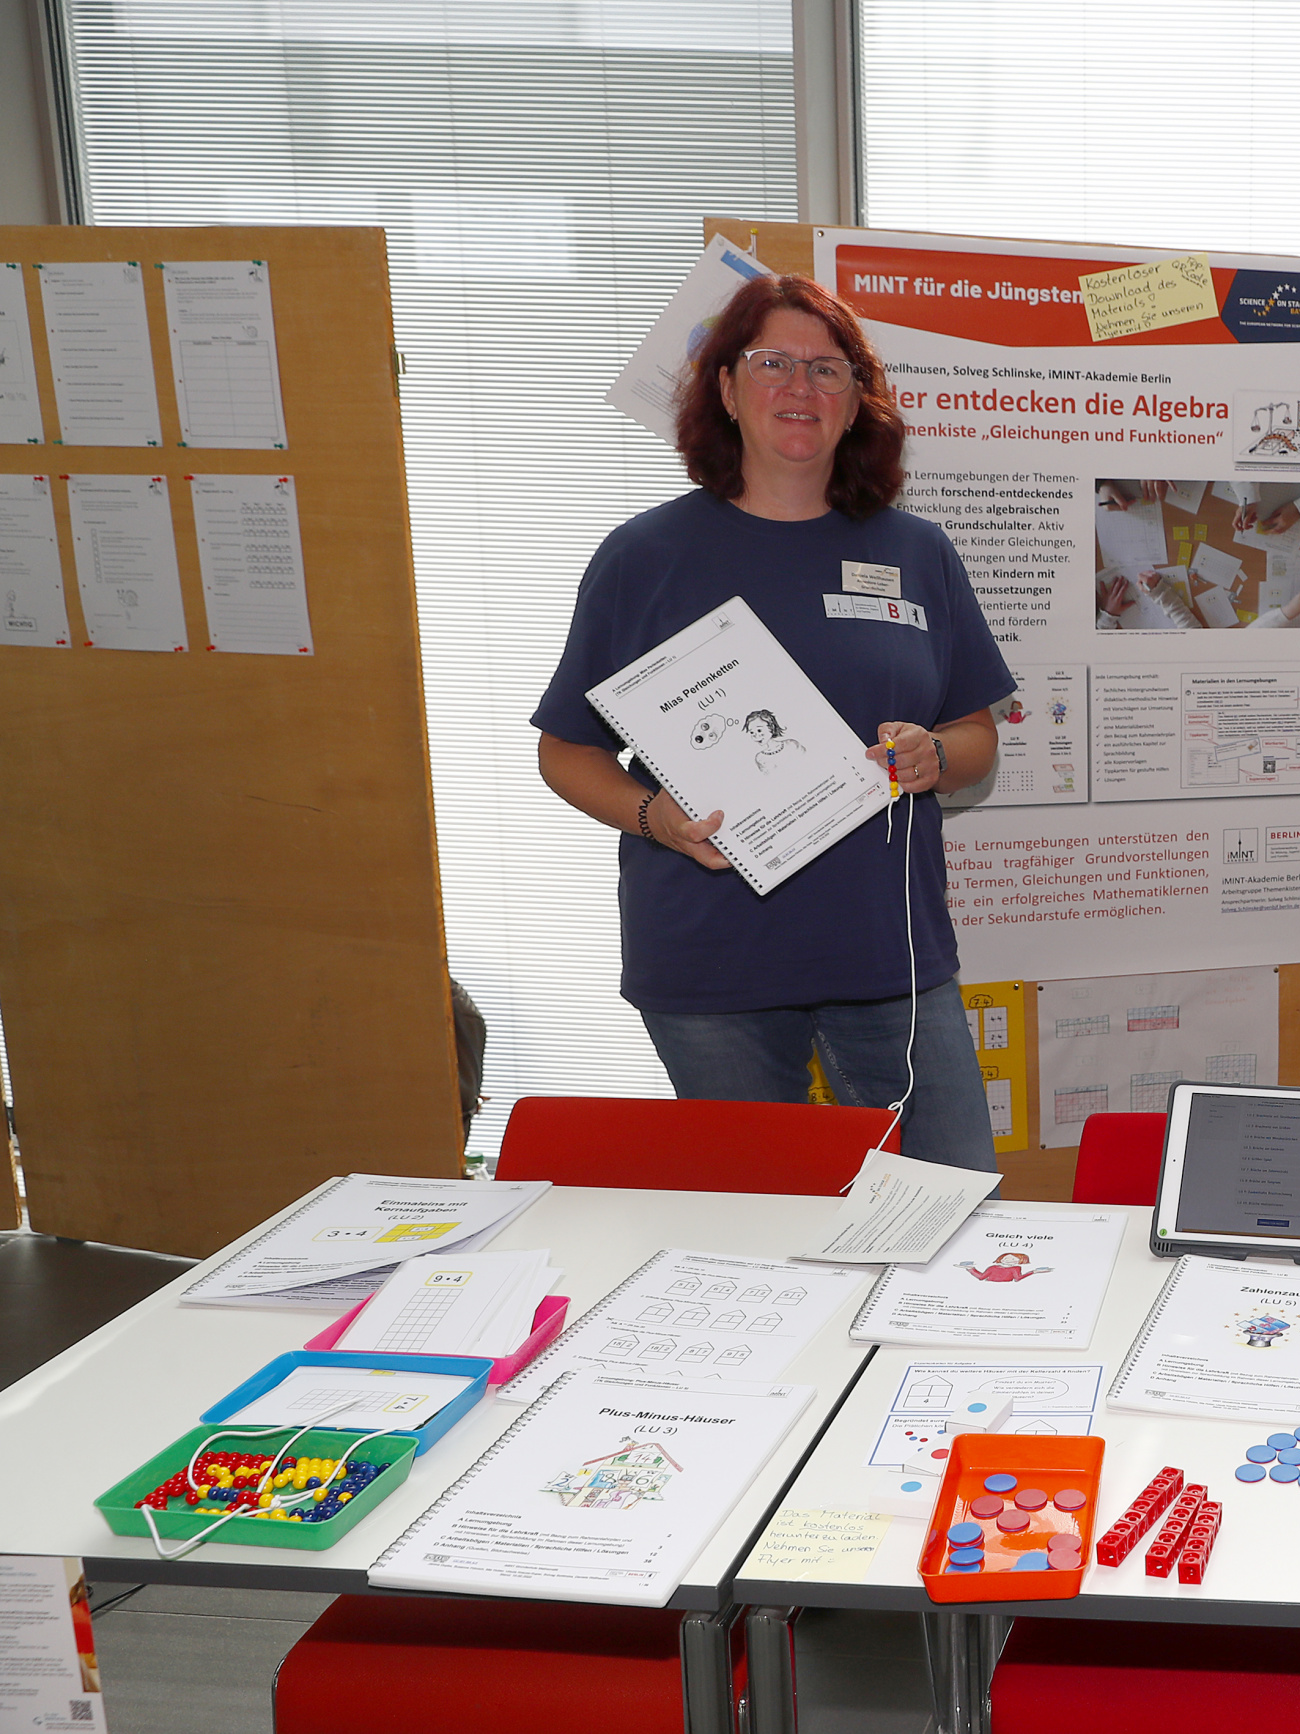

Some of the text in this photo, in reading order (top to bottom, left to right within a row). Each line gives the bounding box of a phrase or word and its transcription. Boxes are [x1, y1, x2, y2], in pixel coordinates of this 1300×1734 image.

[1086, 264, 1161, 290] Kostenloser
[855, 274, 1085, 305] MINT für die Jüngsten
[1087, 280, 1176, 305] Download des
[1239, 298, 1265, 306] SCIENCE
[953, 366, 989, 378] Solveg
[992, 367, 1046, 380] Schlinske,
[1048, 369, 1138, 383] iMINT-Akademie
[1141, 373, 1171, 384] Berlin
[937, 388, 1228, 422] entdecken die Algebra
[1094, 427, 1124, 442] und
[915, 471, 1079, 483] Lernumgebungen der Themen-
[907, 488, 1073, 499] durch forschend-entdeckendes
[965, 506, 983, 514] des
[986, 506, 1059, 516] algebraischen
[946, 521, 1064, 533] Grundschulalter. Aktiv
[971, 538, 1005, 546] Kinder
[1008, 539, 1075, 549] Gleichungen,
[1009, 554, 1070, 563] und Muster.
[993, 570, 1055, 579] Kindern mit
[1031, 601, 1050, 610] und
[1009, 617, 1047, 626] fördern
[659, 657, 740, 714] Mias Perlenketten
[944, 830, 1209, 852] Die Lernumgebungen unterstützen den
[945, 849, 1209, 872] Aufbau tragfähiger Grundvorstellungen
[945, 867, 1209, 890] zu Termen, Gleichungen und Funktionen,
[1222, 875, 1284, 885] iMINT-Akademie
[946, 884, 1209, 908] die ein erfolgreiches Mathematiklernen
[962, 904, 1165, 926] der Sekundarstufe ermöglichen.
[380, 1199, 445, 1208] Einmaleins
[374, 1206, 457, 1214] Kernaufgaben
[985, 1232, 1026, 1241] Gleich
[598, 1407, 736, 1427] Plus-Minus-Häuser
[633, 1424, 658, 1435] (LU
[779, 1510, 880, 1520] Das Material
[804, 1521, 864, 1530] kostenlos
[763, 1542, 811, 1552] Nehmen
[758, 1554, 795, 1566] Flyer
